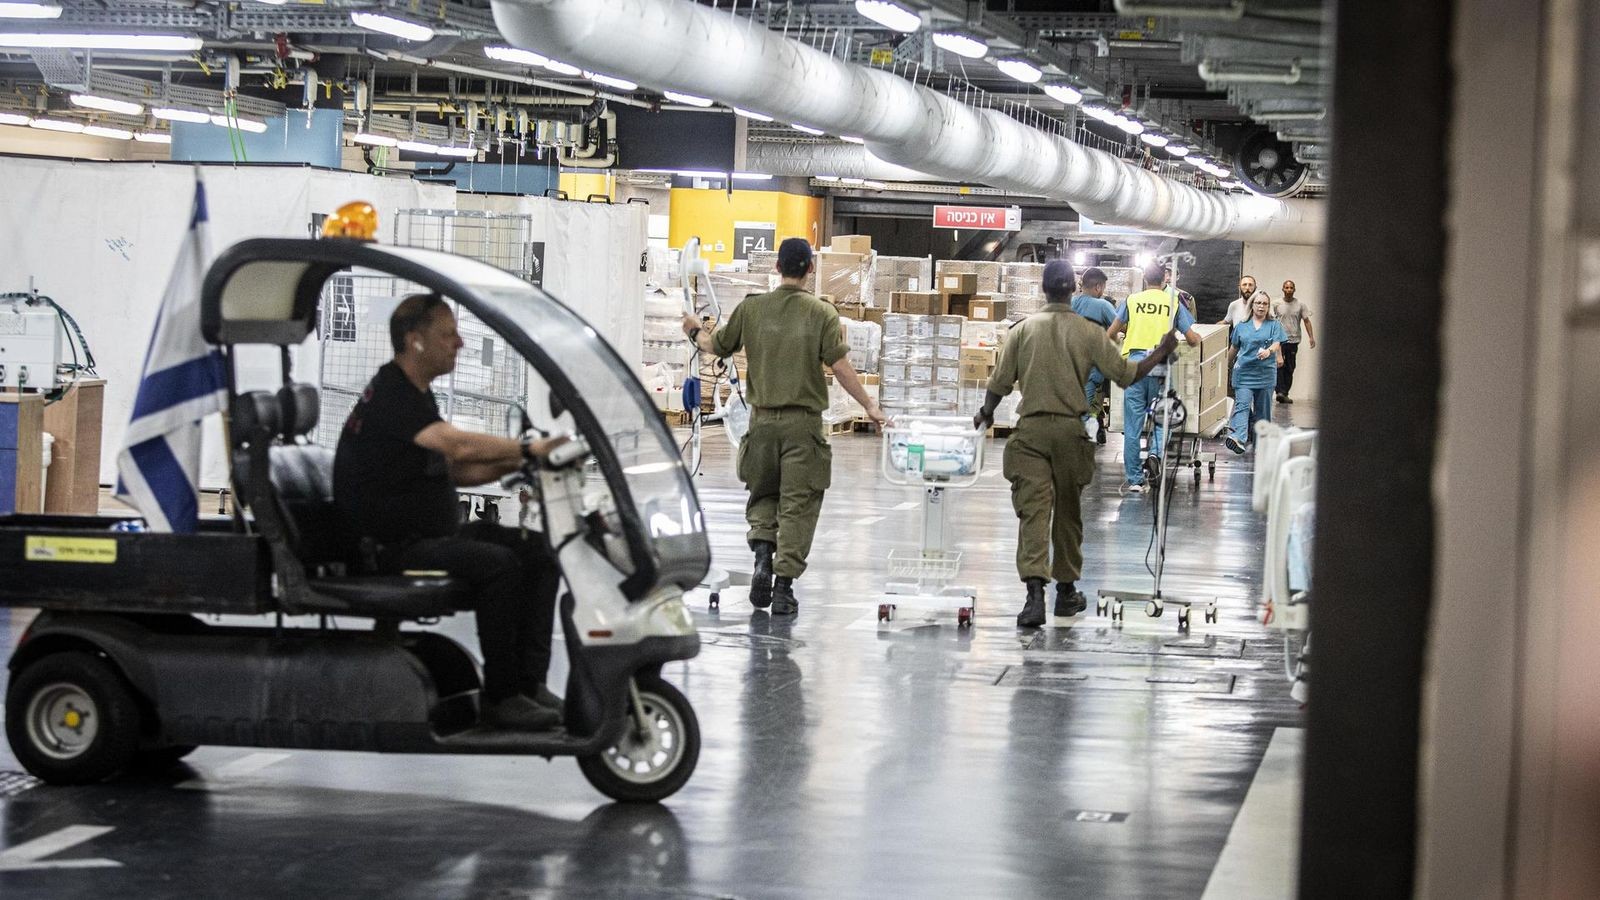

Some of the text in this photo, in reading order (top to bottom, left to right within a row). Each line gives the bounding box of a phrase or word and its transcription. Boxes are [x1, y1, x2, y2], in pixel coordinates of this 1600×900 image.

[947, 211, 995, 226] אין כניסה
[742, 236, 767, 254] F4
[1136, 302, 1171, 317] רופא
